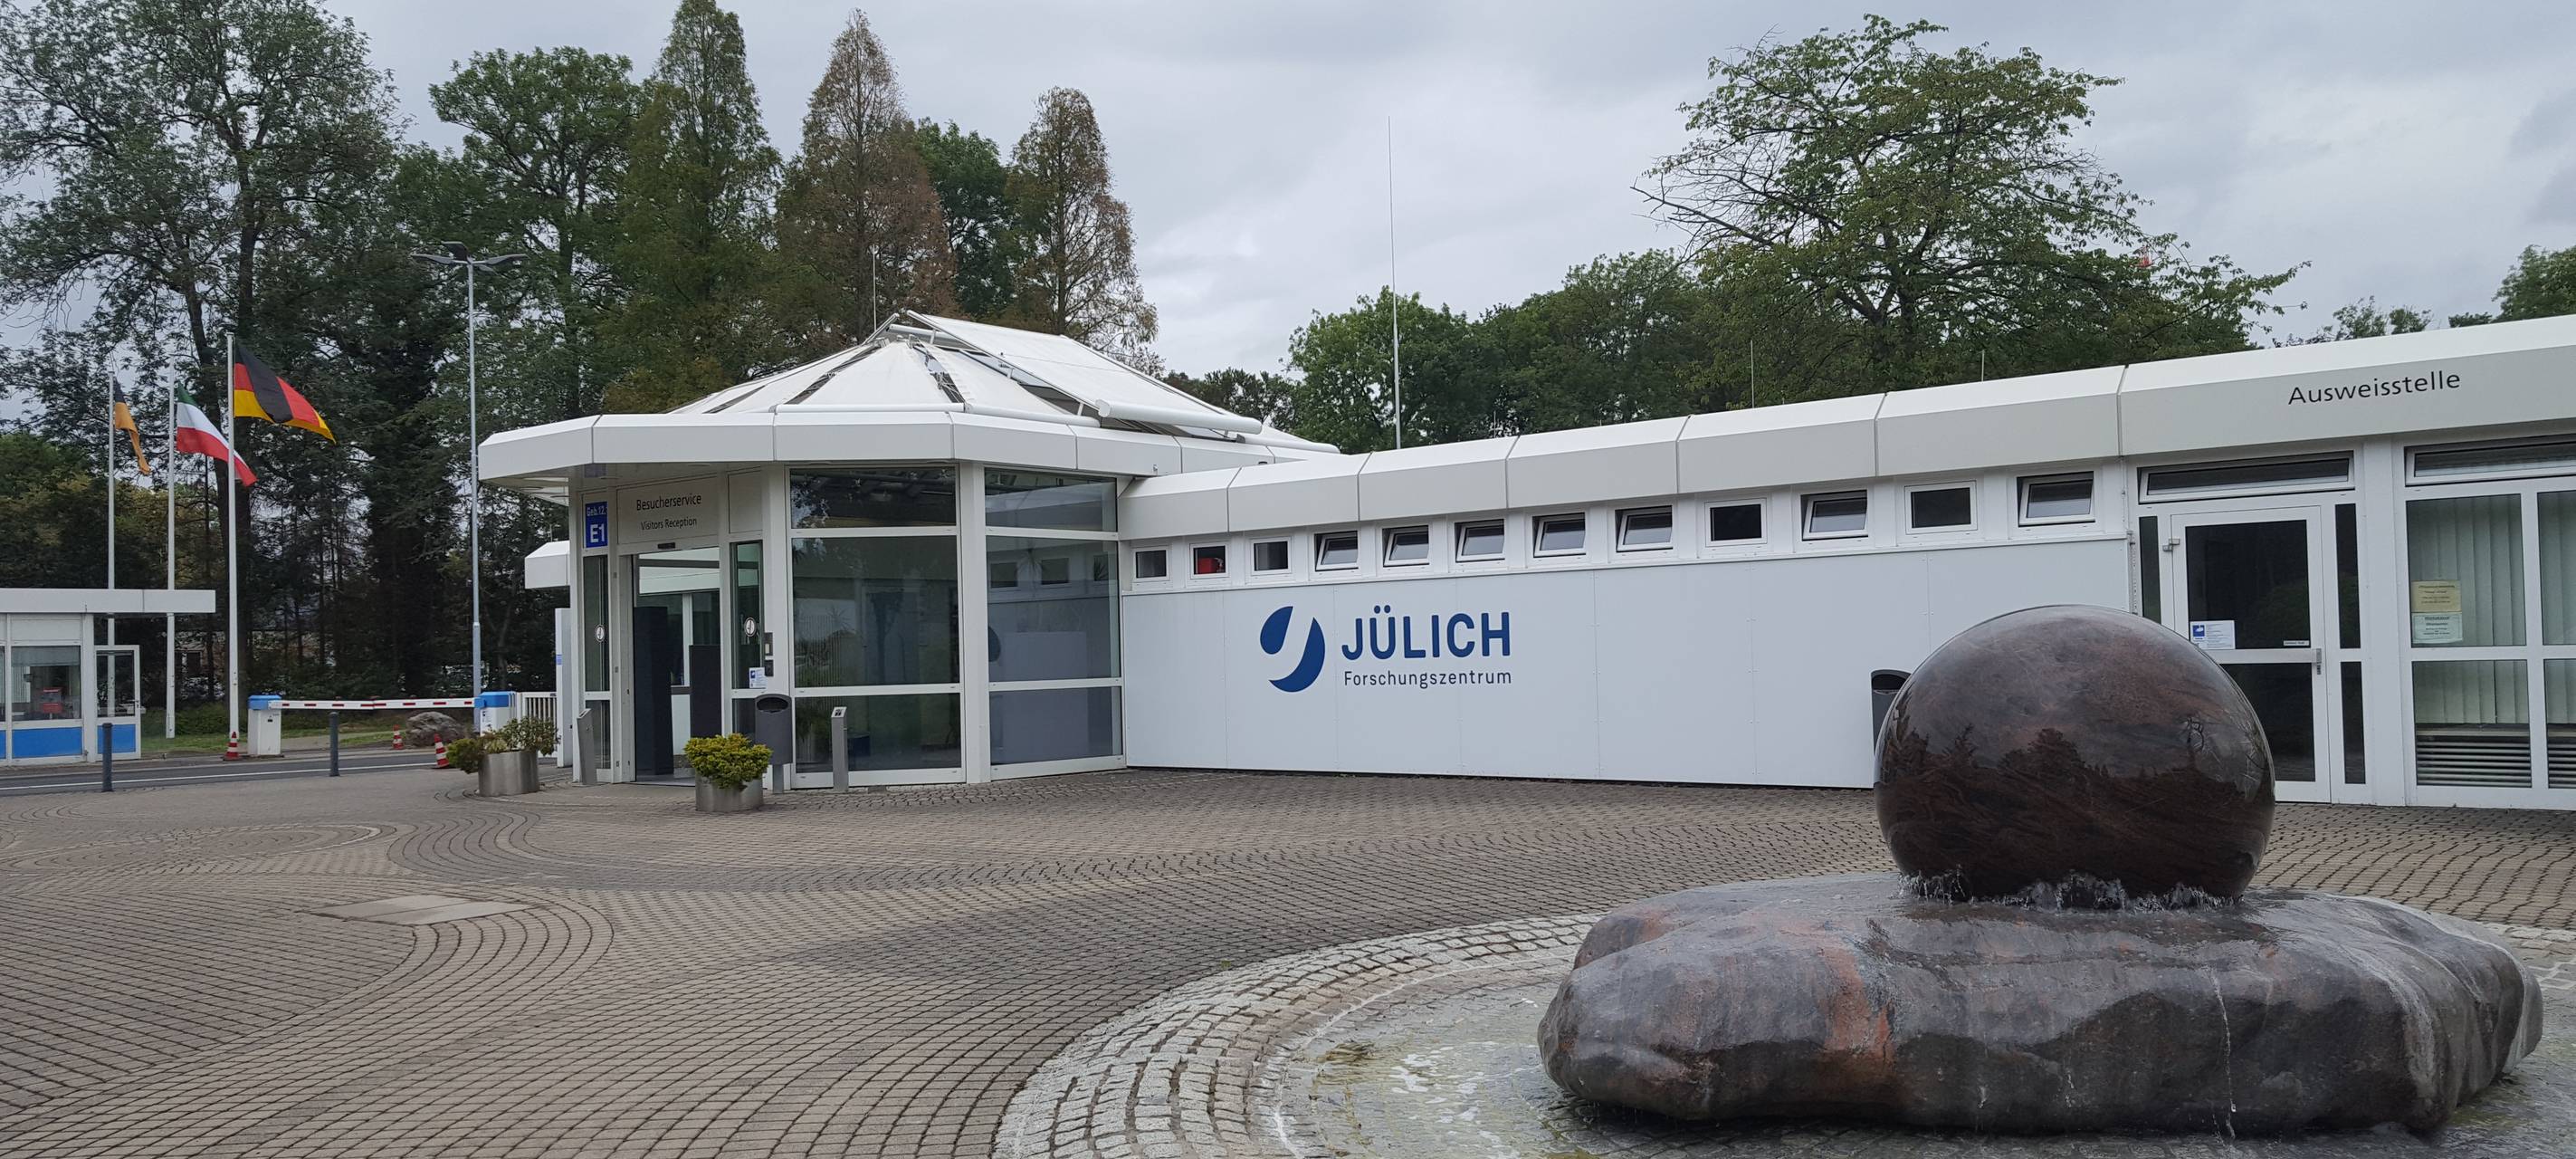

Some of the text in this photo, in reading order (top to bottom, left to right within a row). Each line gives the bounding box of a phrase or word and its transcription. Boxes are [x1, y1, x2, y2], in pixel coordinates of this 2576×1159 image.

[2288, 370, 2460, 405] Ausweisstelle
[636, 493, 701, 511] Besucherservice
[590, 523, 605, 543] E1
[640, 516, 697, 531] Visitors Reception
[1341, 604, 1511, 661] JÜLICH
[1344, 669, 1512, 689] Forschungszentrum
